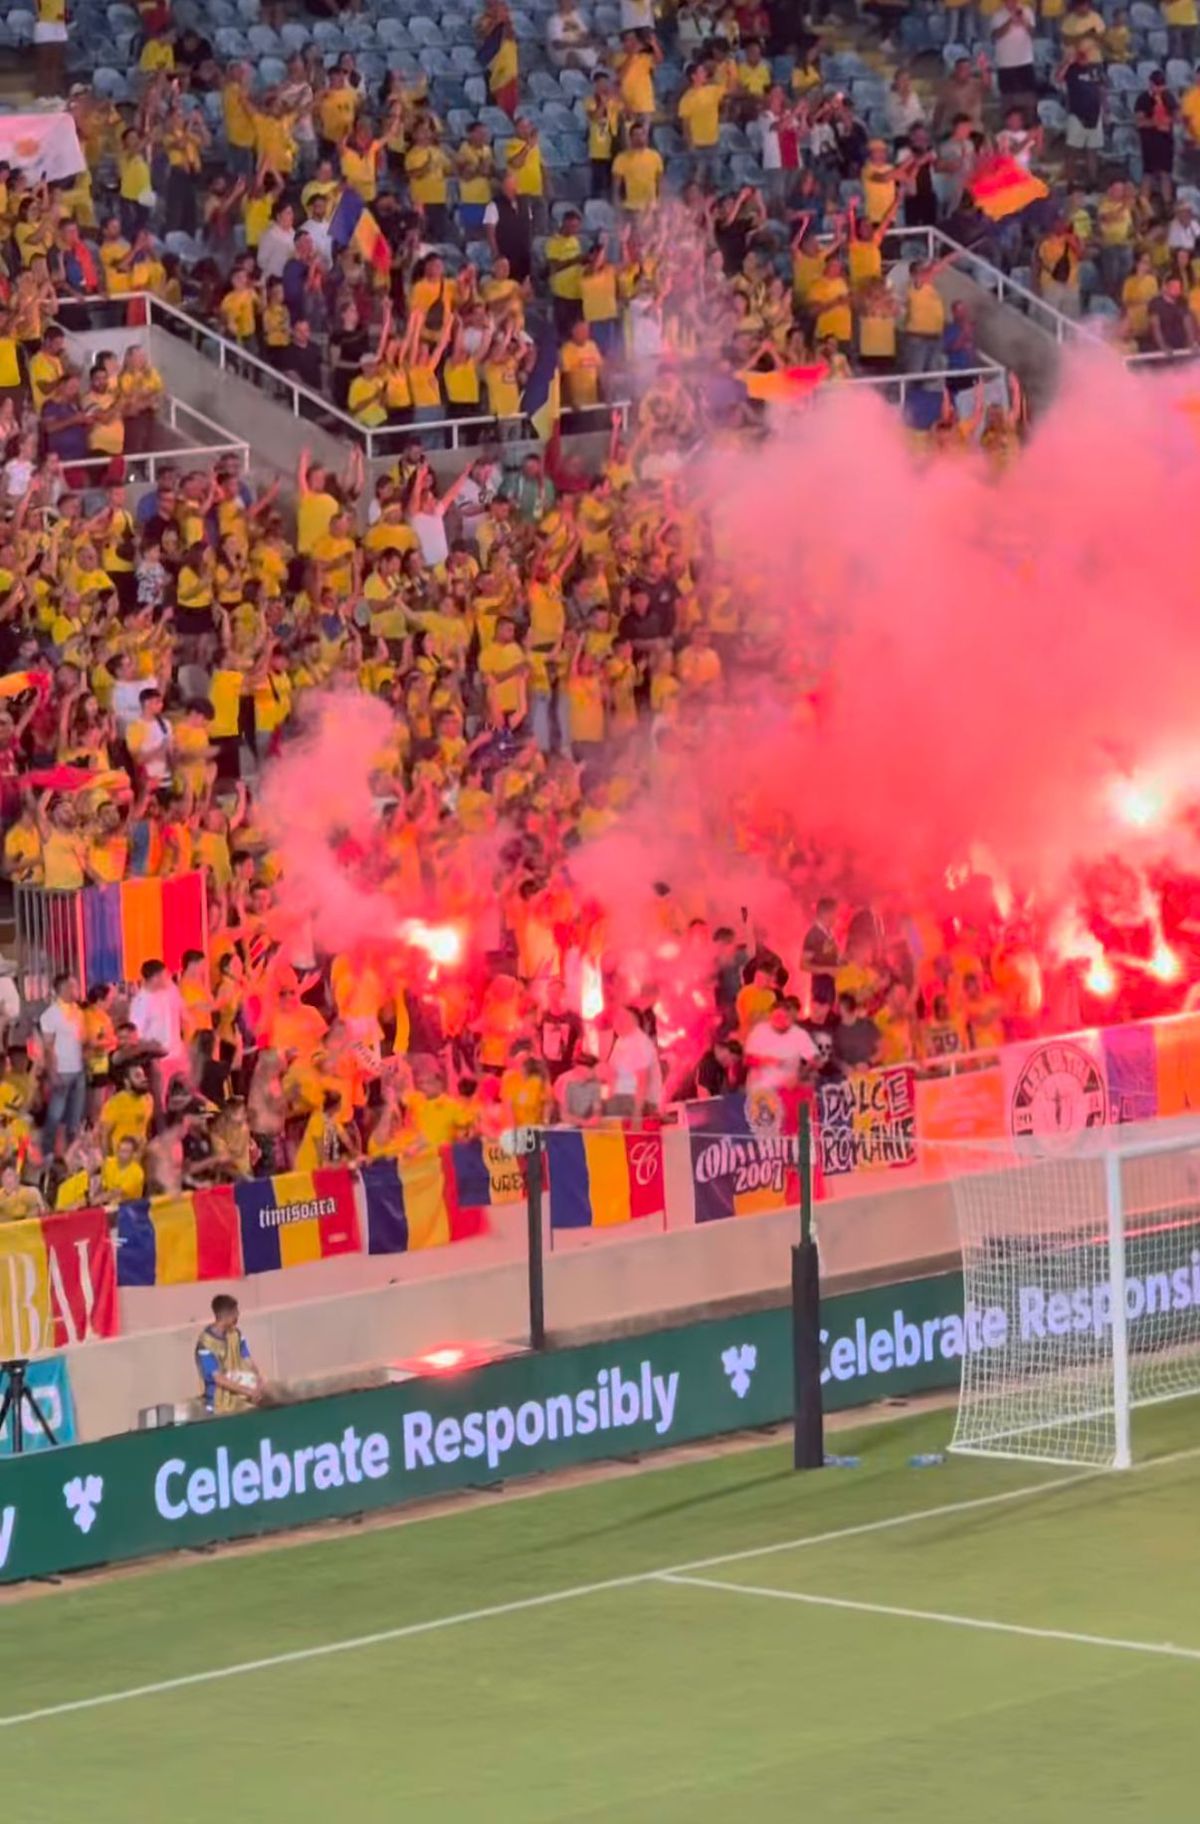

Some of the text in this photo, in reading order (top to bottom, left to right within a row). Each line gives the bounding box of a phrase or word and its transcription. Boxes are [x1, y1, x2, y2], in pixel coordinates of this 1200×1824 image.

[734, 1157, 784, 1194] 2007
[154, 1360, 680, 1520] Celebrate Responsibly
